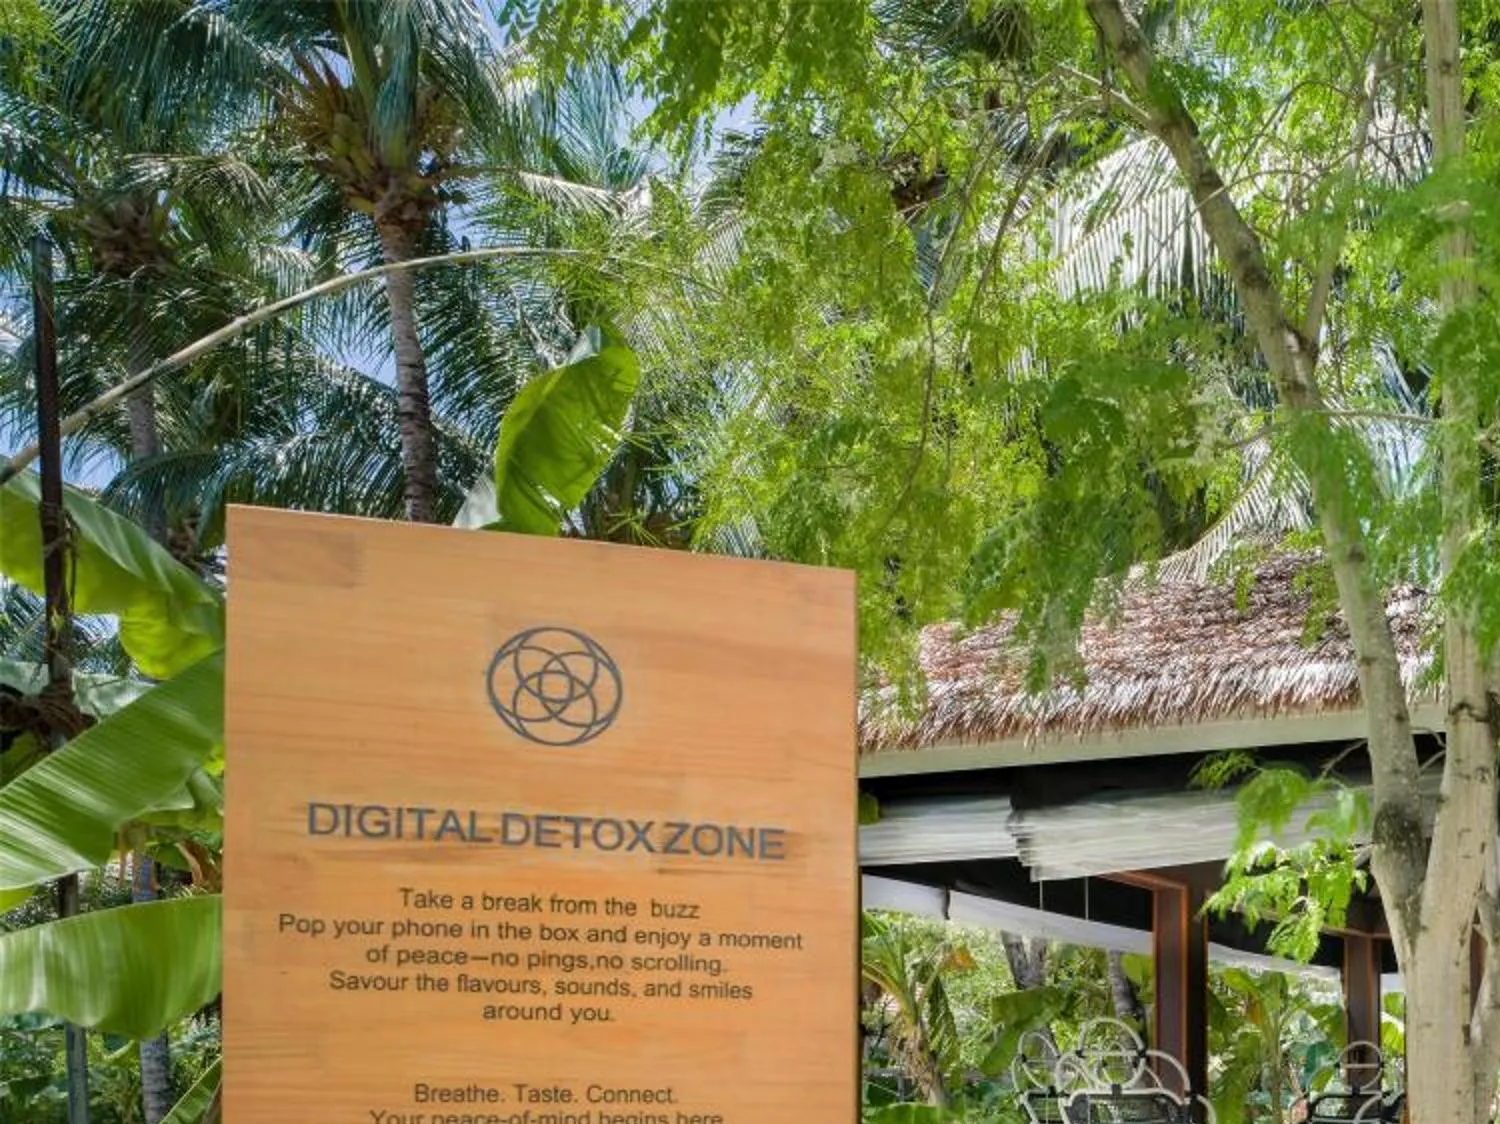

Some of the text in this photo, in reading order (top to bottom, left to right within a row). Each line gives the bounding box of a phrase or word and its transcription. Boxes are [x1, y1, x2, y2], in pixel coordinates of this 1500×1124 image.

[308, 803, 786, 860] DIGITAL DETOX ZONE
[399, 887, 700, 919] Take a break from the buzz
[278, 913, 803, 950] Pop your phone in the box and enjoy a moment
[366, 944, 391, 963] of
[329, 969, 409, 991] Savour
[416, 973, 449, 991] the
[457, 973, 547, 996] flavours,
[643, 981, 681, 998] and
[689, 982, 753, 1000] smiles
[483, 1003, 562, 1021] around
[414, 1083, 678, 1104] Breathe. Taste. Connect.
